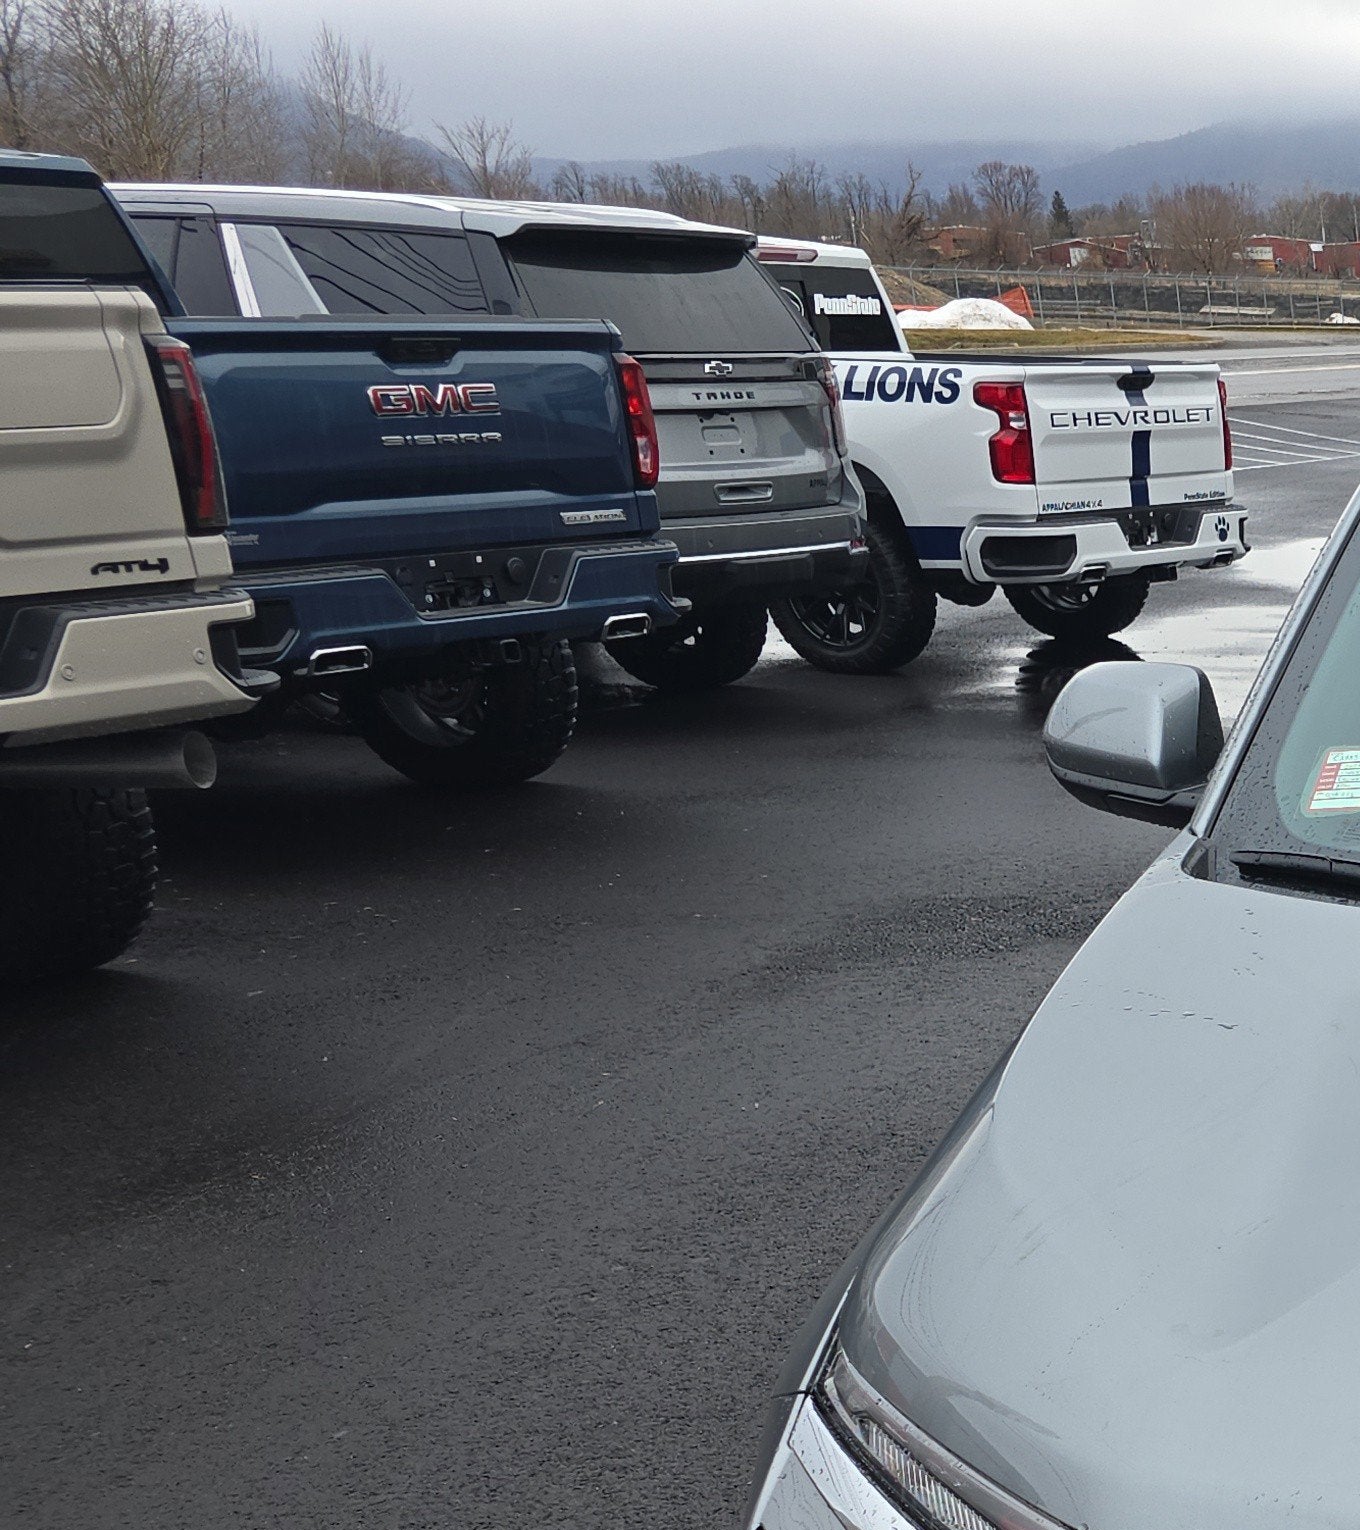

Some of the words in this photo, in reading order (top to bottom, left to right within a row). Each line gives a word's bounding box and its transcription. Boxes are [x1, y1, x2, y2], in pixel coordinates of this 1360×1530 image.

[842, 365, 963, 404] LIONS
[366, 382, 502, 417] GMC
[692, 391, 756, 401] TAHOE
[1050, 407, 1214, 428] CHEVROLET
[381, 432, 502, 446] SIERRA
[91, 557, 169, 575] AT4
